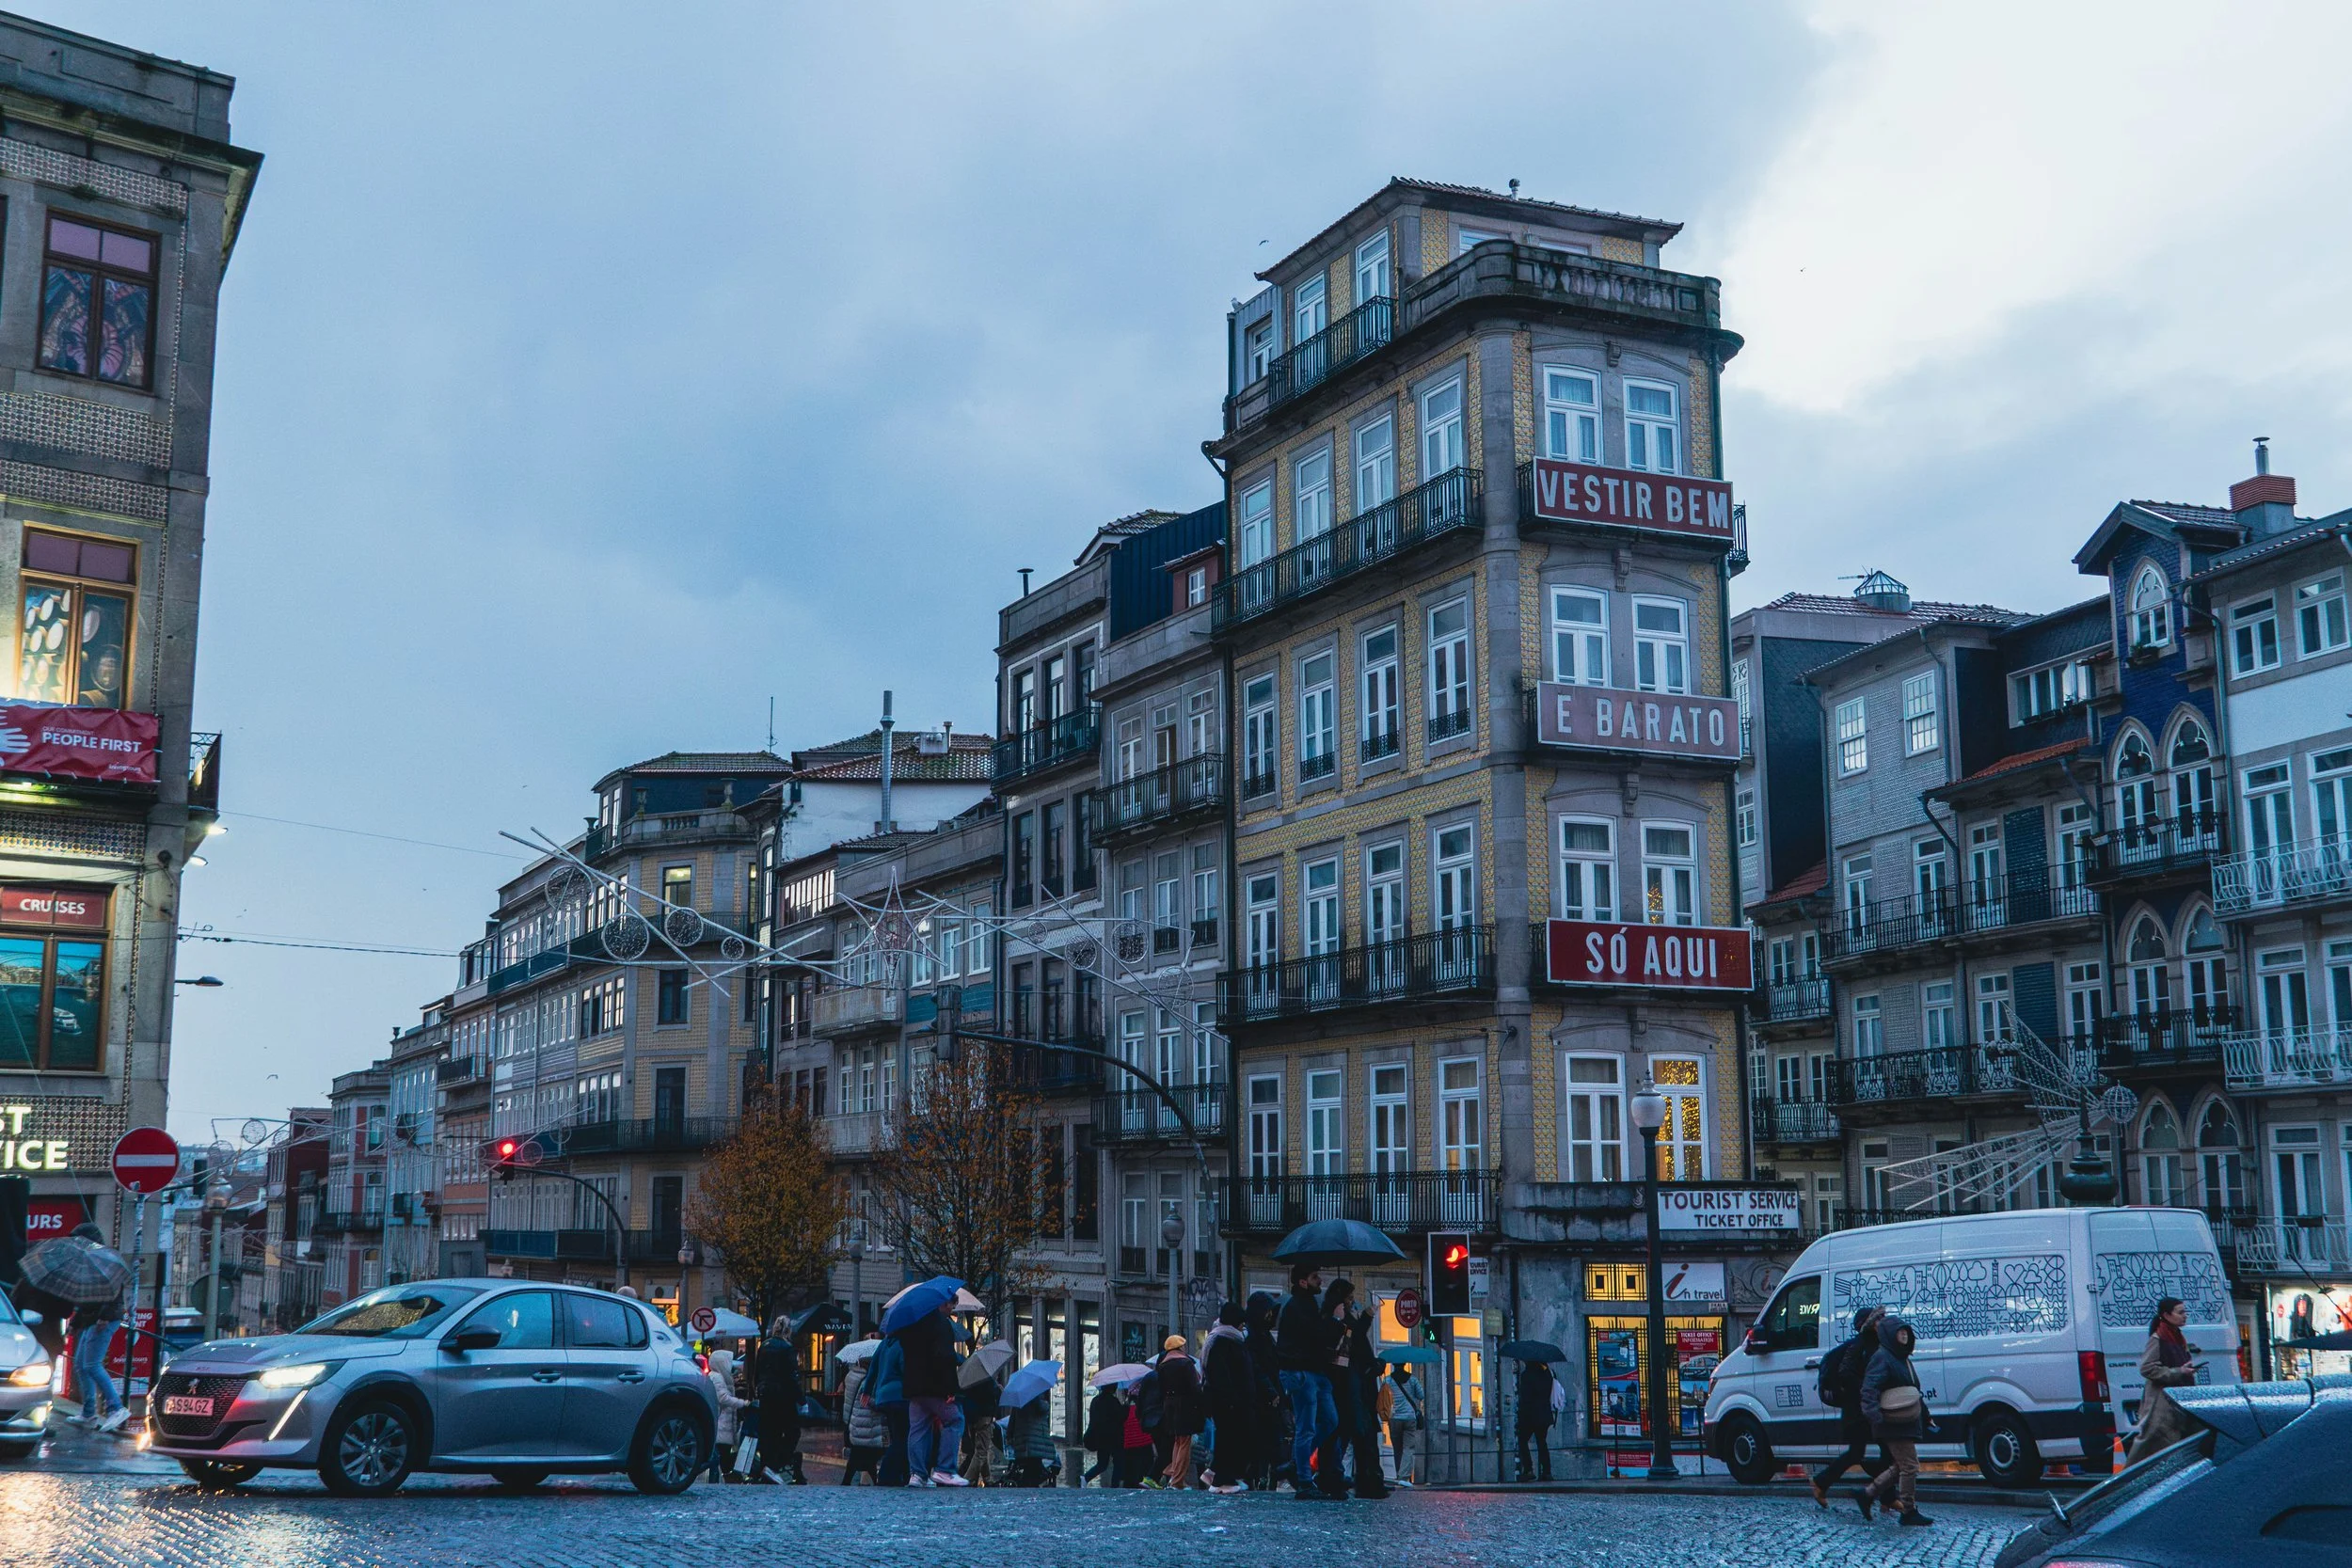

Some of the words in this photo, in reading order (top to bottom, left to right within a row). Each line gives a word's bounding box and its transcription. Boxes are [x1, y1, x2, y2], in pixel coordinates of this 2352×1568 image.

[1539, 469, 1653, 519] VESTIR
[1666, 484, 1728, 529] BEM
[1557, 694, 1572, 734] E
[1597, 698, 1724, 746] BARATO
[42, 732, 98, 749] PEOPLE
[101, 737, 142, 753] FIRST
[20, 898, 86, 915] CRUISES
[1586, 927, 1627, 974] SÓ
[1645, 936, 1717, 978] AQUI
[0, 1106, 32, 1135] T
[0, 1140, 69, 1170] ICE
[1661, 1192, 1742, 1210] TOURIST
[1749, 1192, 1796, 1210] SERVICE
[1695, 1214, 1743, 1227] TICKET
[1748, 1214, 1784, 1227] OFFICE
[1694, 1289, 1724, 1300] travel
